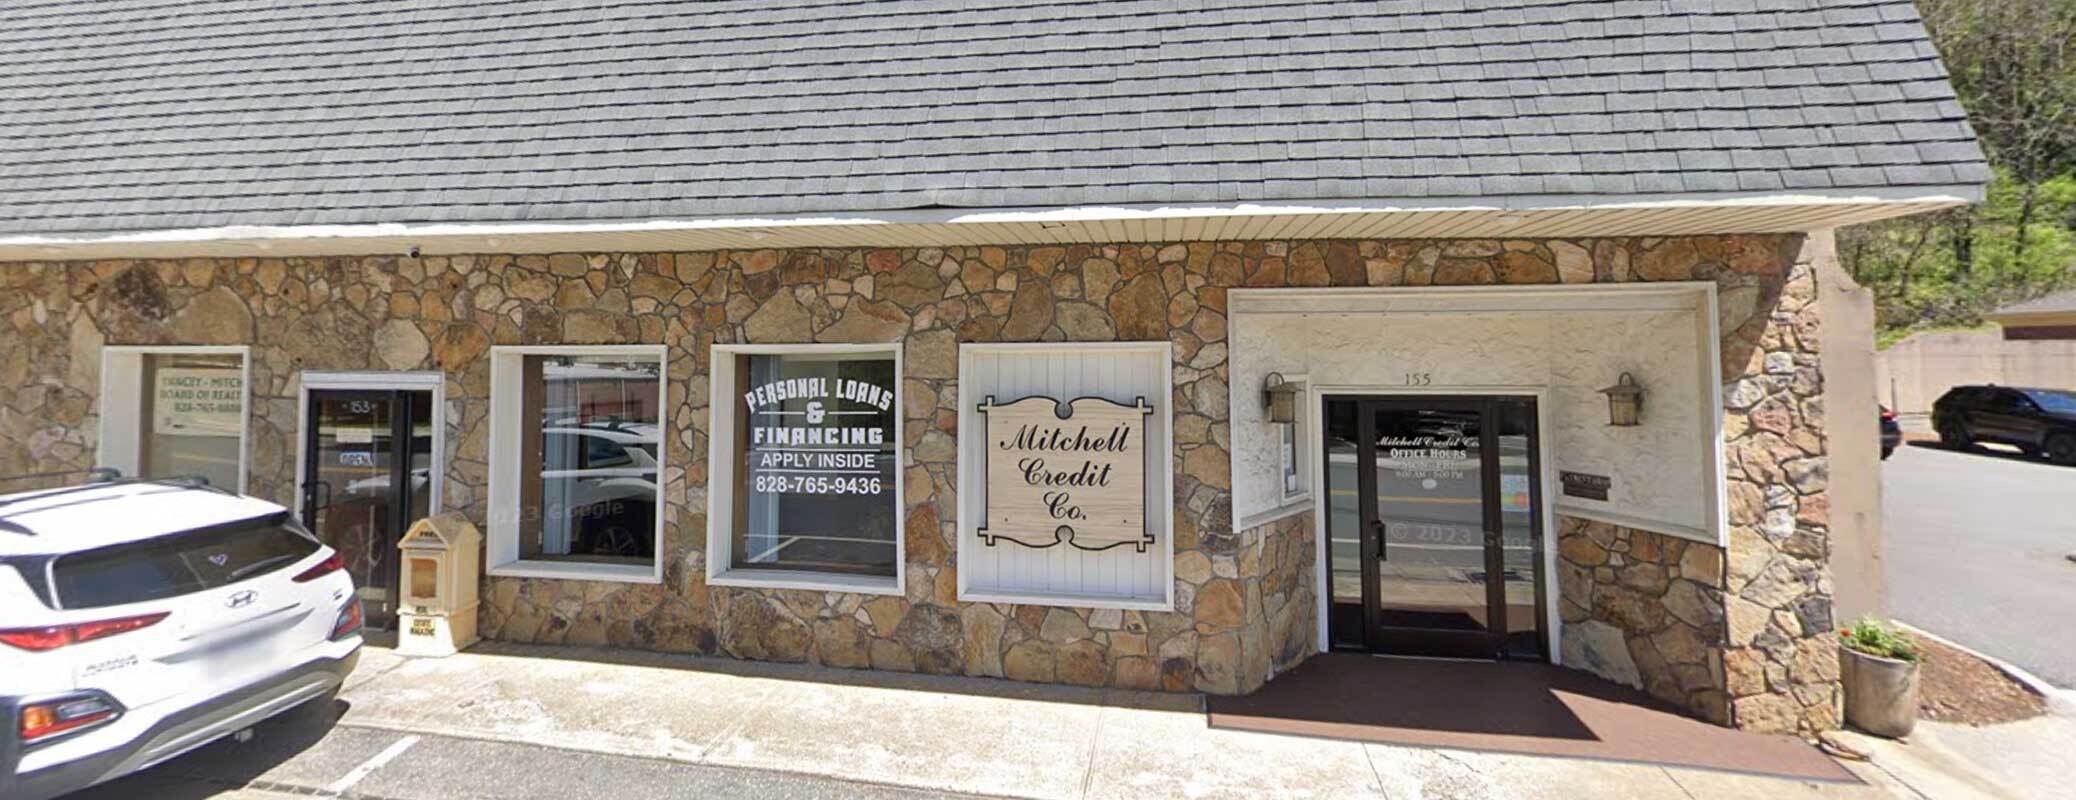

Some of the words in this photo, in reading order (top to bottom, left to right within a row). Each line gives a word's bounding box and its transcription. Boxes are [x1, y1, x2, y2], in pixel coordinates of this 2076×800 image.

[1405, 373, 1431, 386] 155
[744, 377, 829, 414] PERSONAL
[835, 378, 894, 411] LOANS
[352, 400, 370, 414] 153
[806, 401, 825, 424] &
[754, 427, 883, 446] FINANCING
[1000, 422, 1130, 452] Mitchell
[760, 453, 813, 467] APPLY
[818, 454, 875, 468] INSIDE
[1430, 448, 1466, 459] HOURS
[1018, 458, 1112, 487] Credit
[756, 476, 881, 494] 828-765-9436
[1043, 491, 1087, 521] Co.
